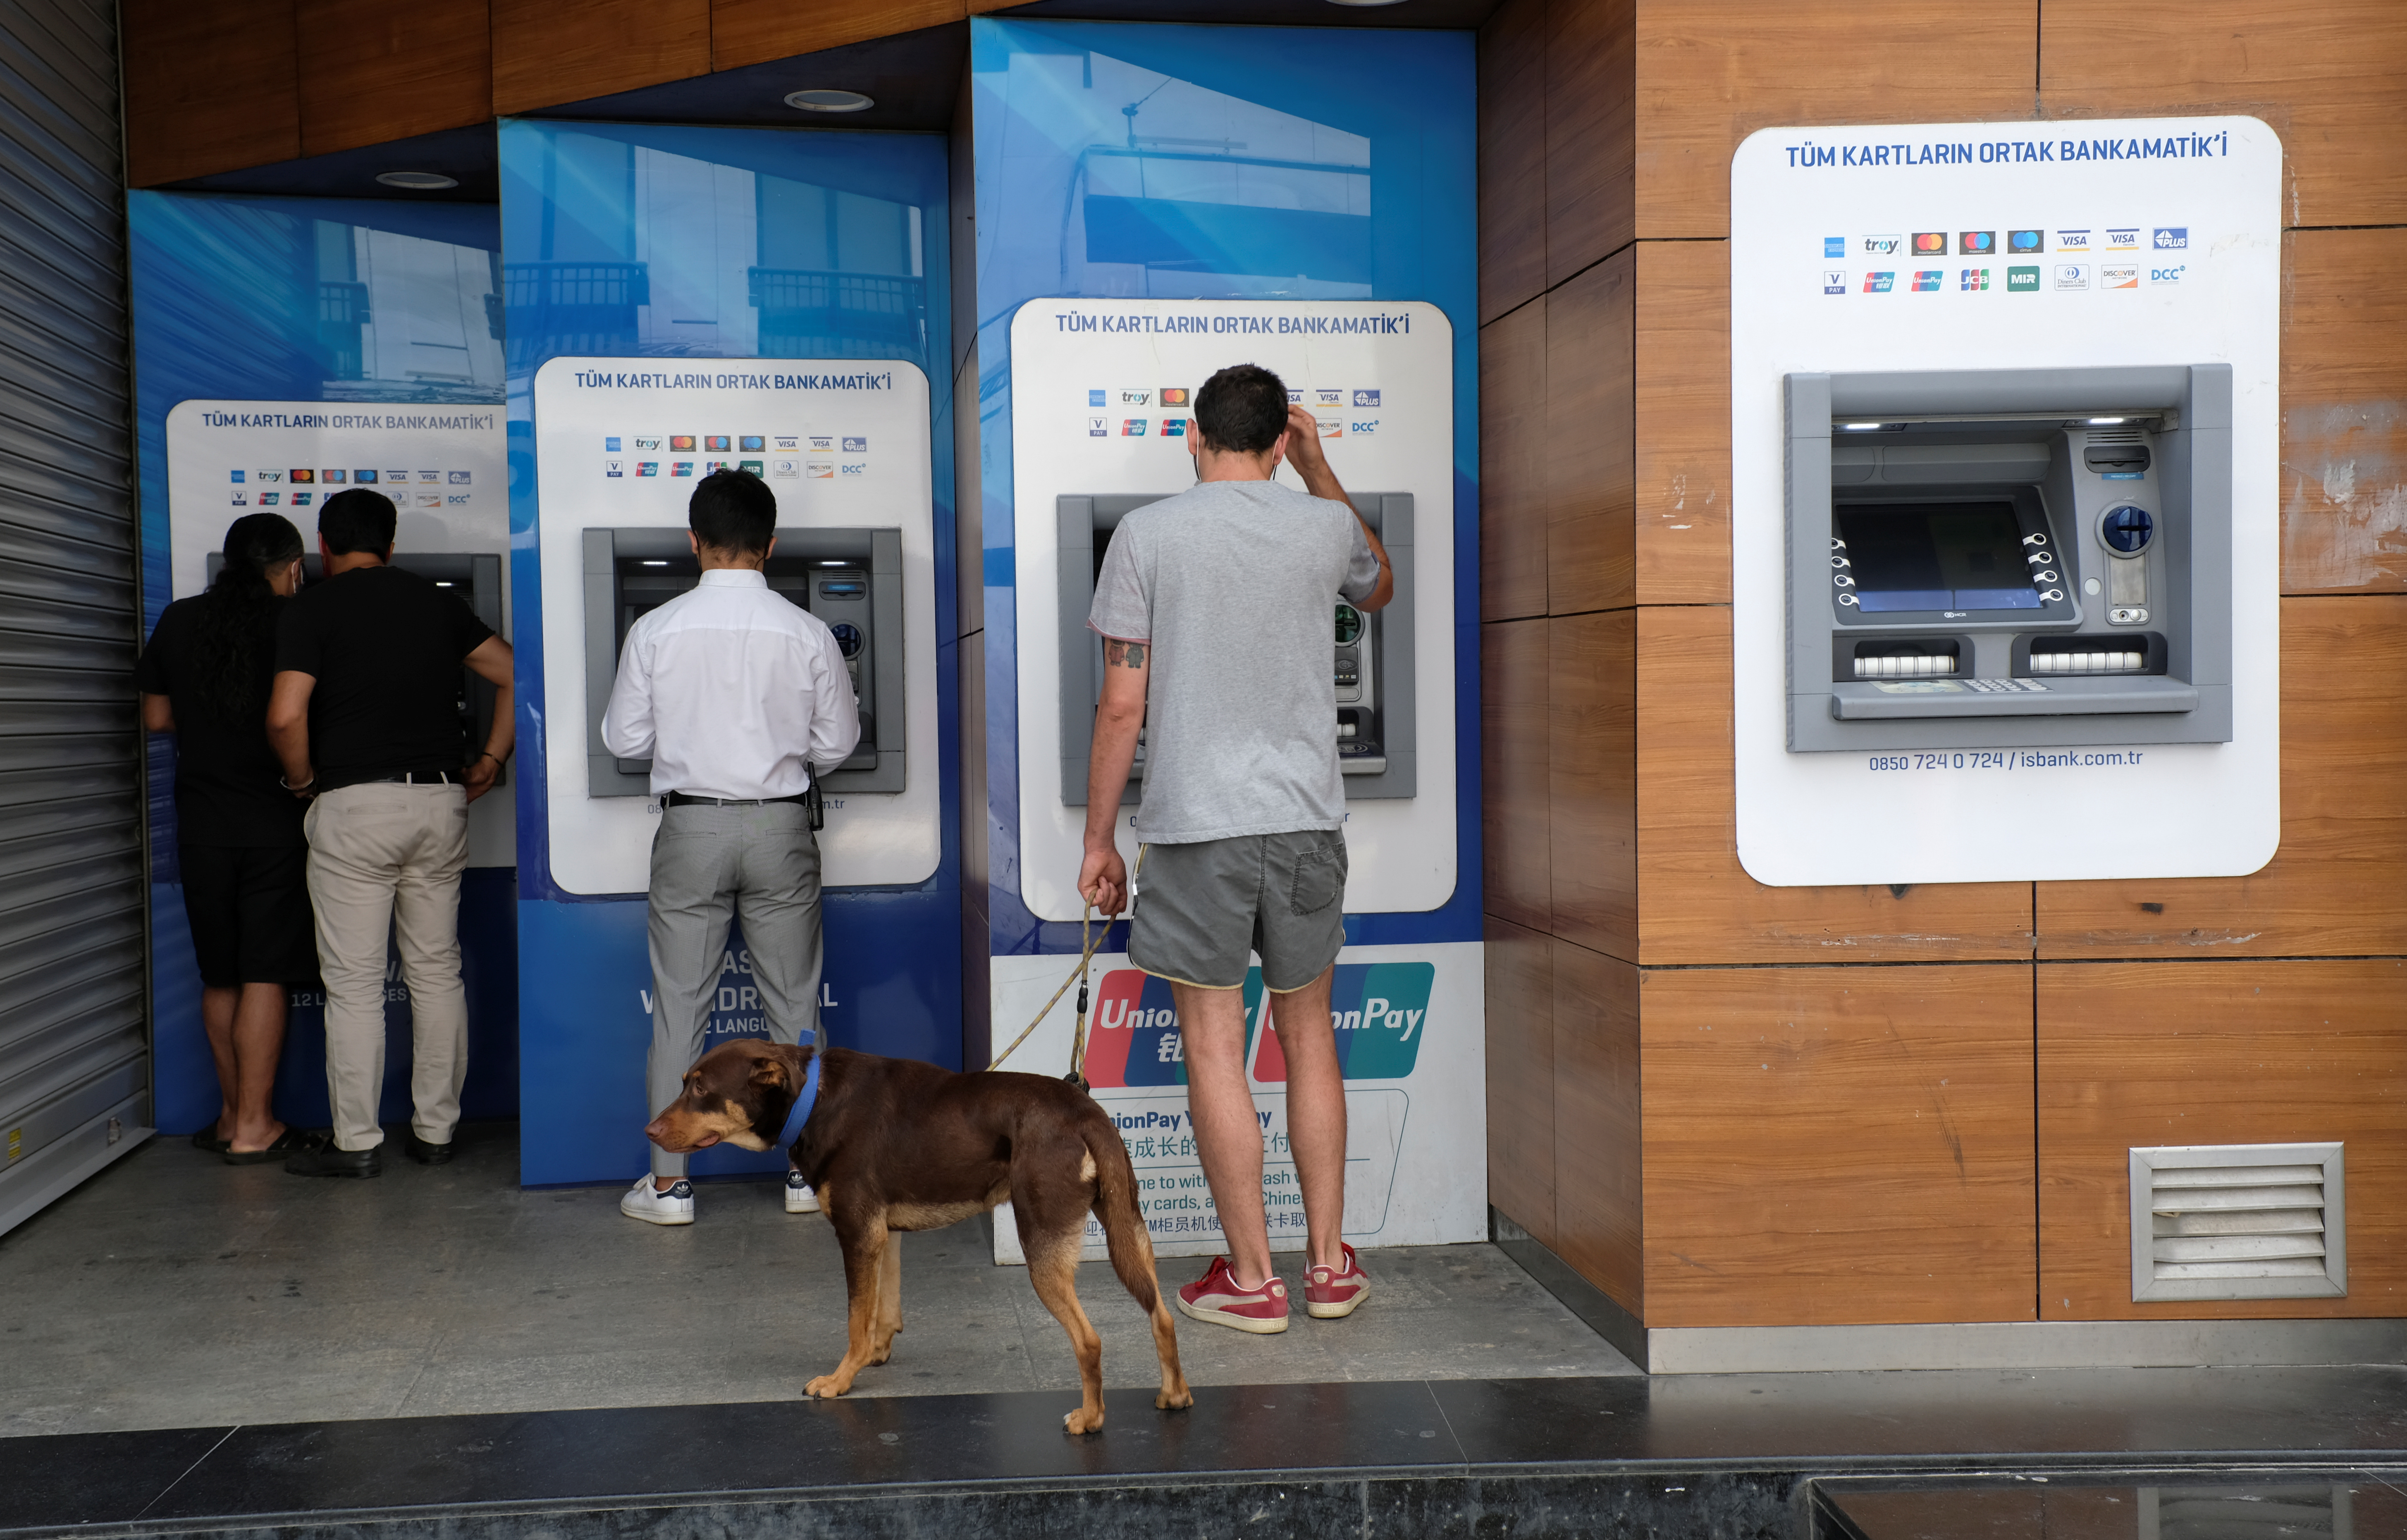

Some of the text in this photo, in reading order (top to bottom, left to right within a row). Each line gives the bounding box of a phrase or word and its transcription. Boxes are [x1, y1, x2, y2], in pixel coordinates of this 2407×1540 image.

[1786, 141, 1835, 167] TÜM
[1843, 143, 1972, 166] KARTLARIN
[1980, 141, 2054, 163] ORTAK
[2060, 236, 2087, 246] VISA
[2110, 234, 2135, 244] VISA
[2163, 238, 2186, 248] PLUS
[1865, 238, 1899, 255] troy
[1828, 274, 1840, 284] V
[1961, 275, 1989, 284] JCB
[2011, 274, 2036, 284] MIR
[2151, 268, 2179, 281] DCC
[1866, 277, 1893, 285] UnionPay
[1914, 276, 1941, 285] UnionPay
[1055, 311, 1097, 332] TÜM
[1102, 315, 1208, 333] KARTLARIN
[1213, 316, 1274, 333] ORTAK
[575, 369, 612, 388] TÜM
[617, 373, 712, 388] KARTLARIN
[716, 374, 770, 389] ORTAK
[1122, 392, 1150, 405] troy
[202, 411, 236, 427] TÜM
[241, 414, 328, 428] KARTLARIN
[332, 415, 382, 429] ORTAK
[1093, 420, 1103, 428] V
[1352, 422, 1374, 432] DCC
[635, 439, 661, 450] troy
[842, 465, 862, 473] DCC
[259, 472, 281, 482] troy
[1869, 757, 1908, 771] 0850
[1914, 753, 1947, 770] 724
[1953, 754, 1964, 769] 0
[1969, 752, 2003, 768] 724
[2021, 750, 2143, 767] isbank.com.tr
[291, 993, 311, 1007] 12
[1159, 1176, 1175, 1189] to
[1263, 1170, 1290, 1185] ash
[1154, 1194, 1201, 1210] cards,
